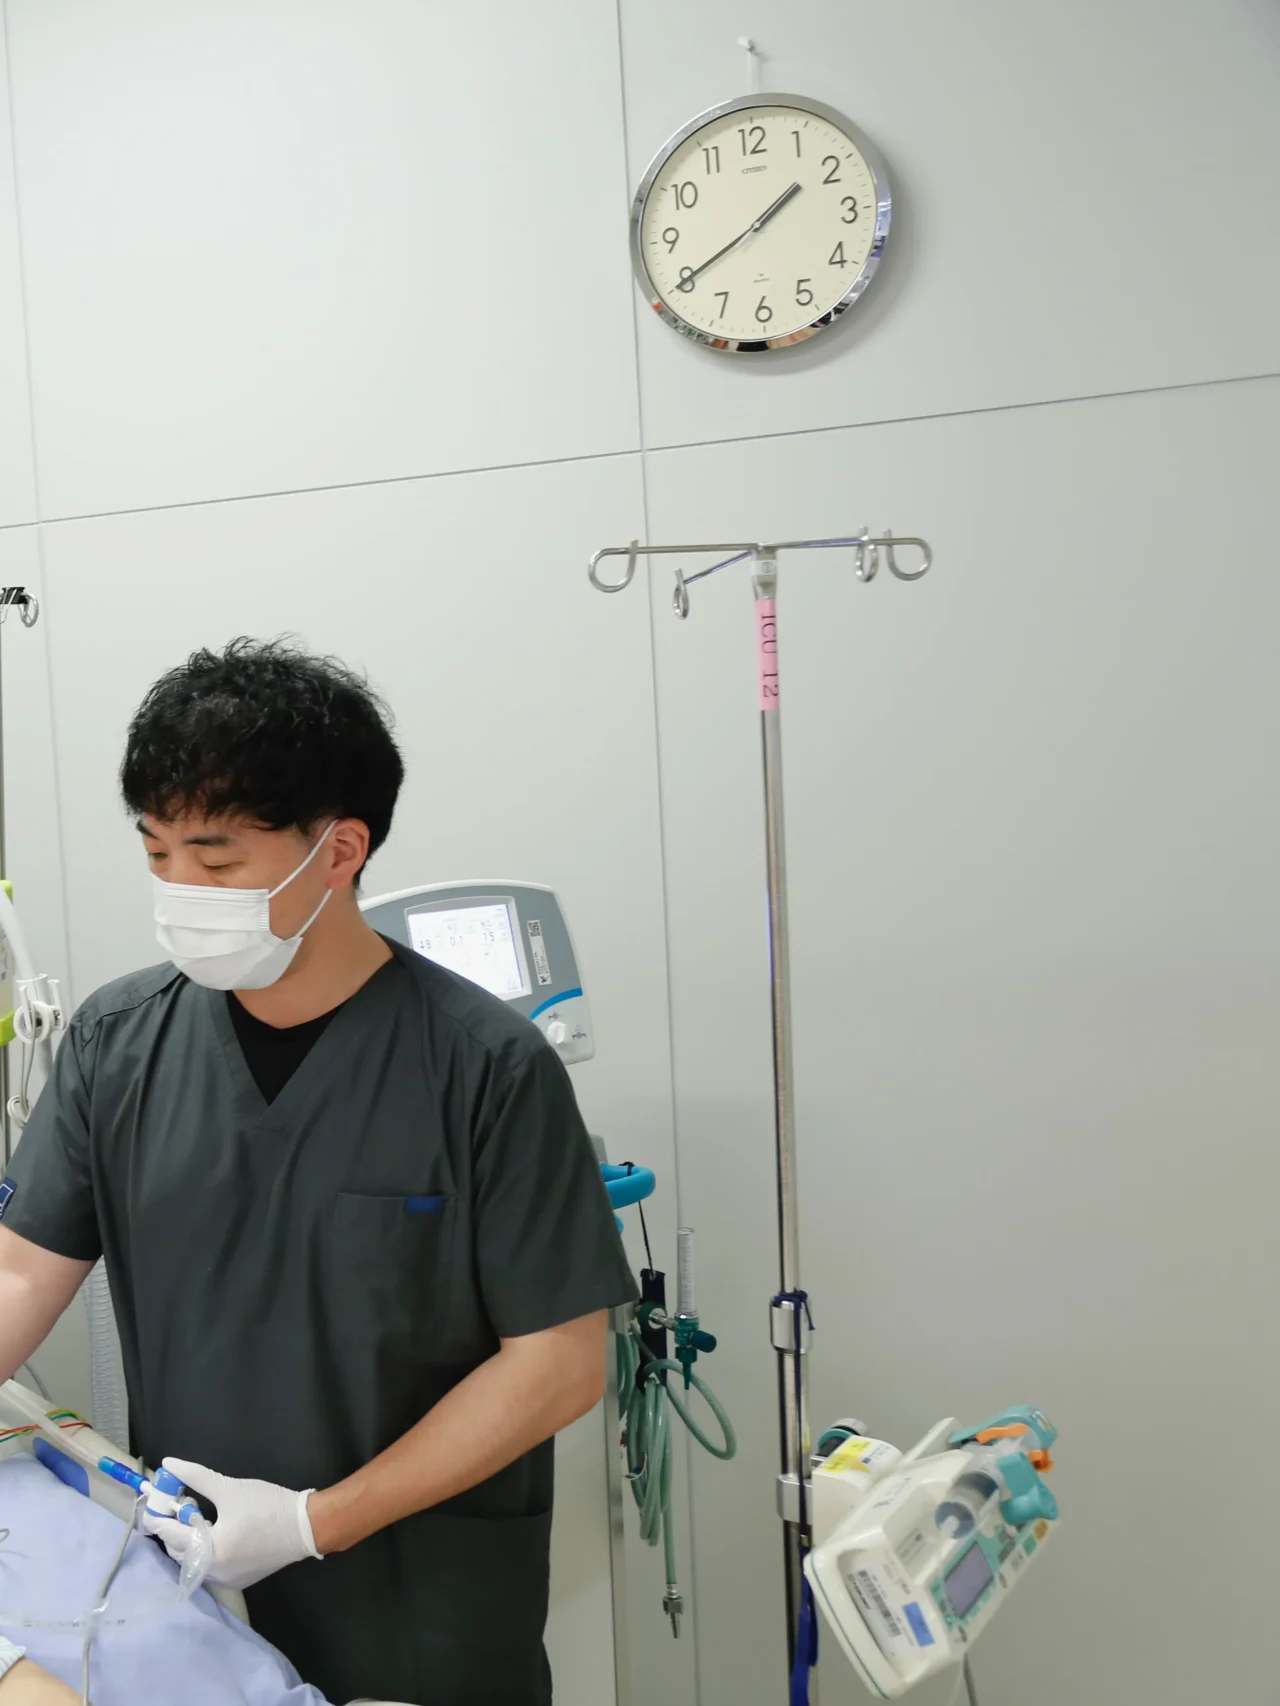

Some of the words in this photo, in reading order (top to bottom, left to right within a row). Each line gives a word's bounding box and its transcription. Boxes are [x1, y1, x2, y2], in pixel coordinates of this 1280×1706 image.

[737, 126, 767, 156] 12
[791, 130, 801, 158] 1
[702, 145, 721, 175] 11
[821, 155, 841, 185] 2
[671, 181, 698, 210] 10
[840, 196, 858, 224] 3
[662, 226, 679, 254] 9
[828, 241, 848, 268] 4
[679, 266, 695, 293] 8
[795, 278, 813, 306] 5
[714, 291, 730, 319] 7
[755, 295, 773, 323] 6
[761, 615, 778, 654] ICU
